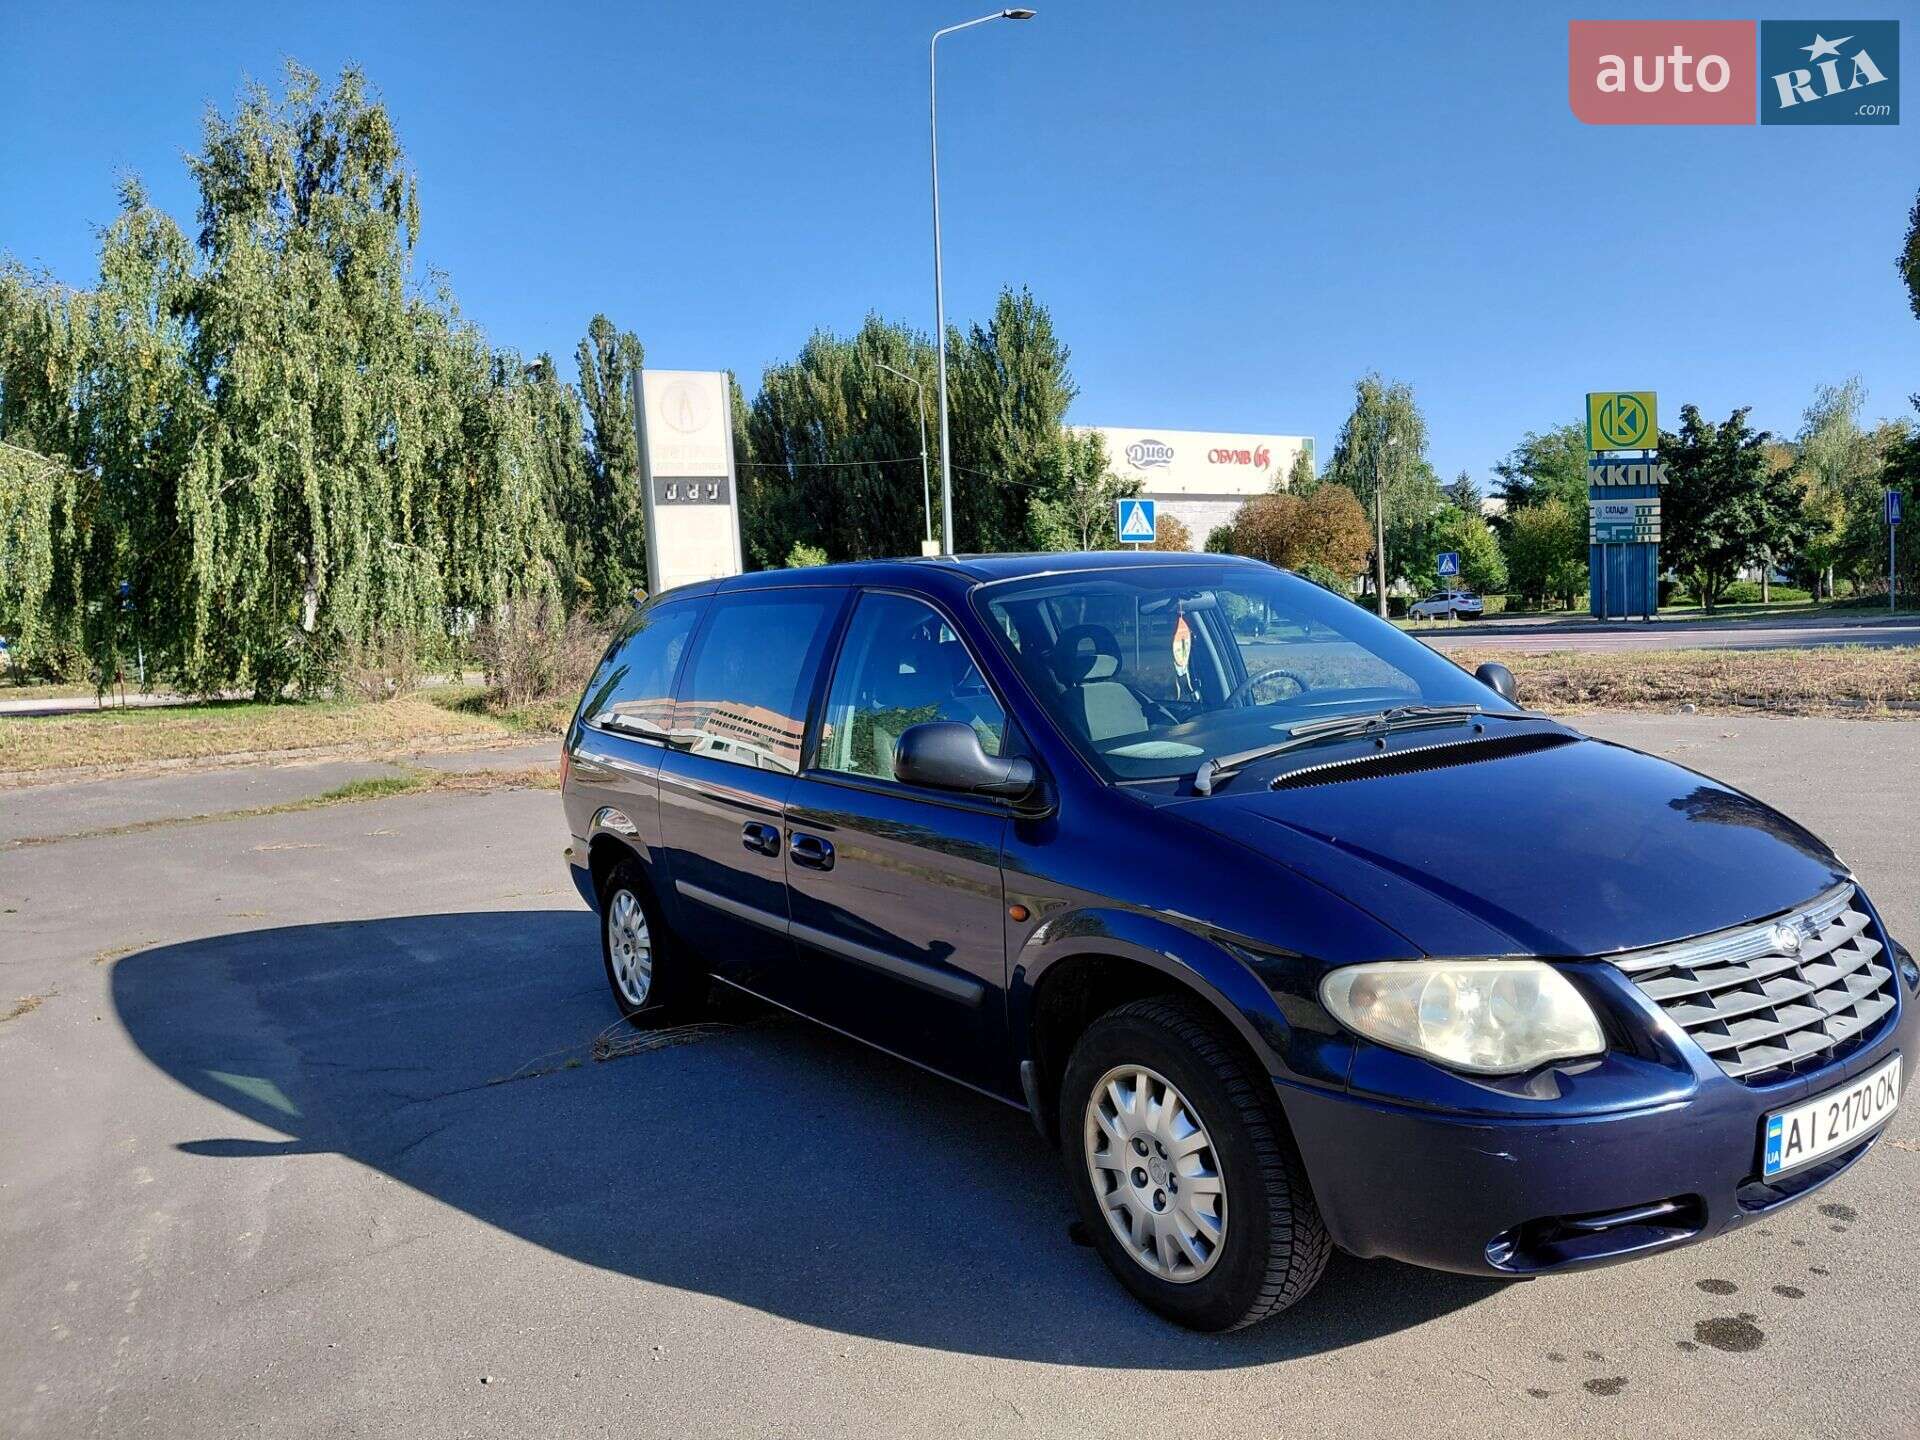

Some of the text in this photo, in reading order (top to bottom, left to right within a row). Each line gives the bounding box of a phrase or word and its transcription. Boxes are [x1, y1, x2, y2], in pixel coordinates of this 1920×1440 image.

[1588, 464, 1670, 485] ККПК
[1785, 1065, 1897, 1158] AI 2170 OK
[1767, 1151, 1780, 1164] UA
